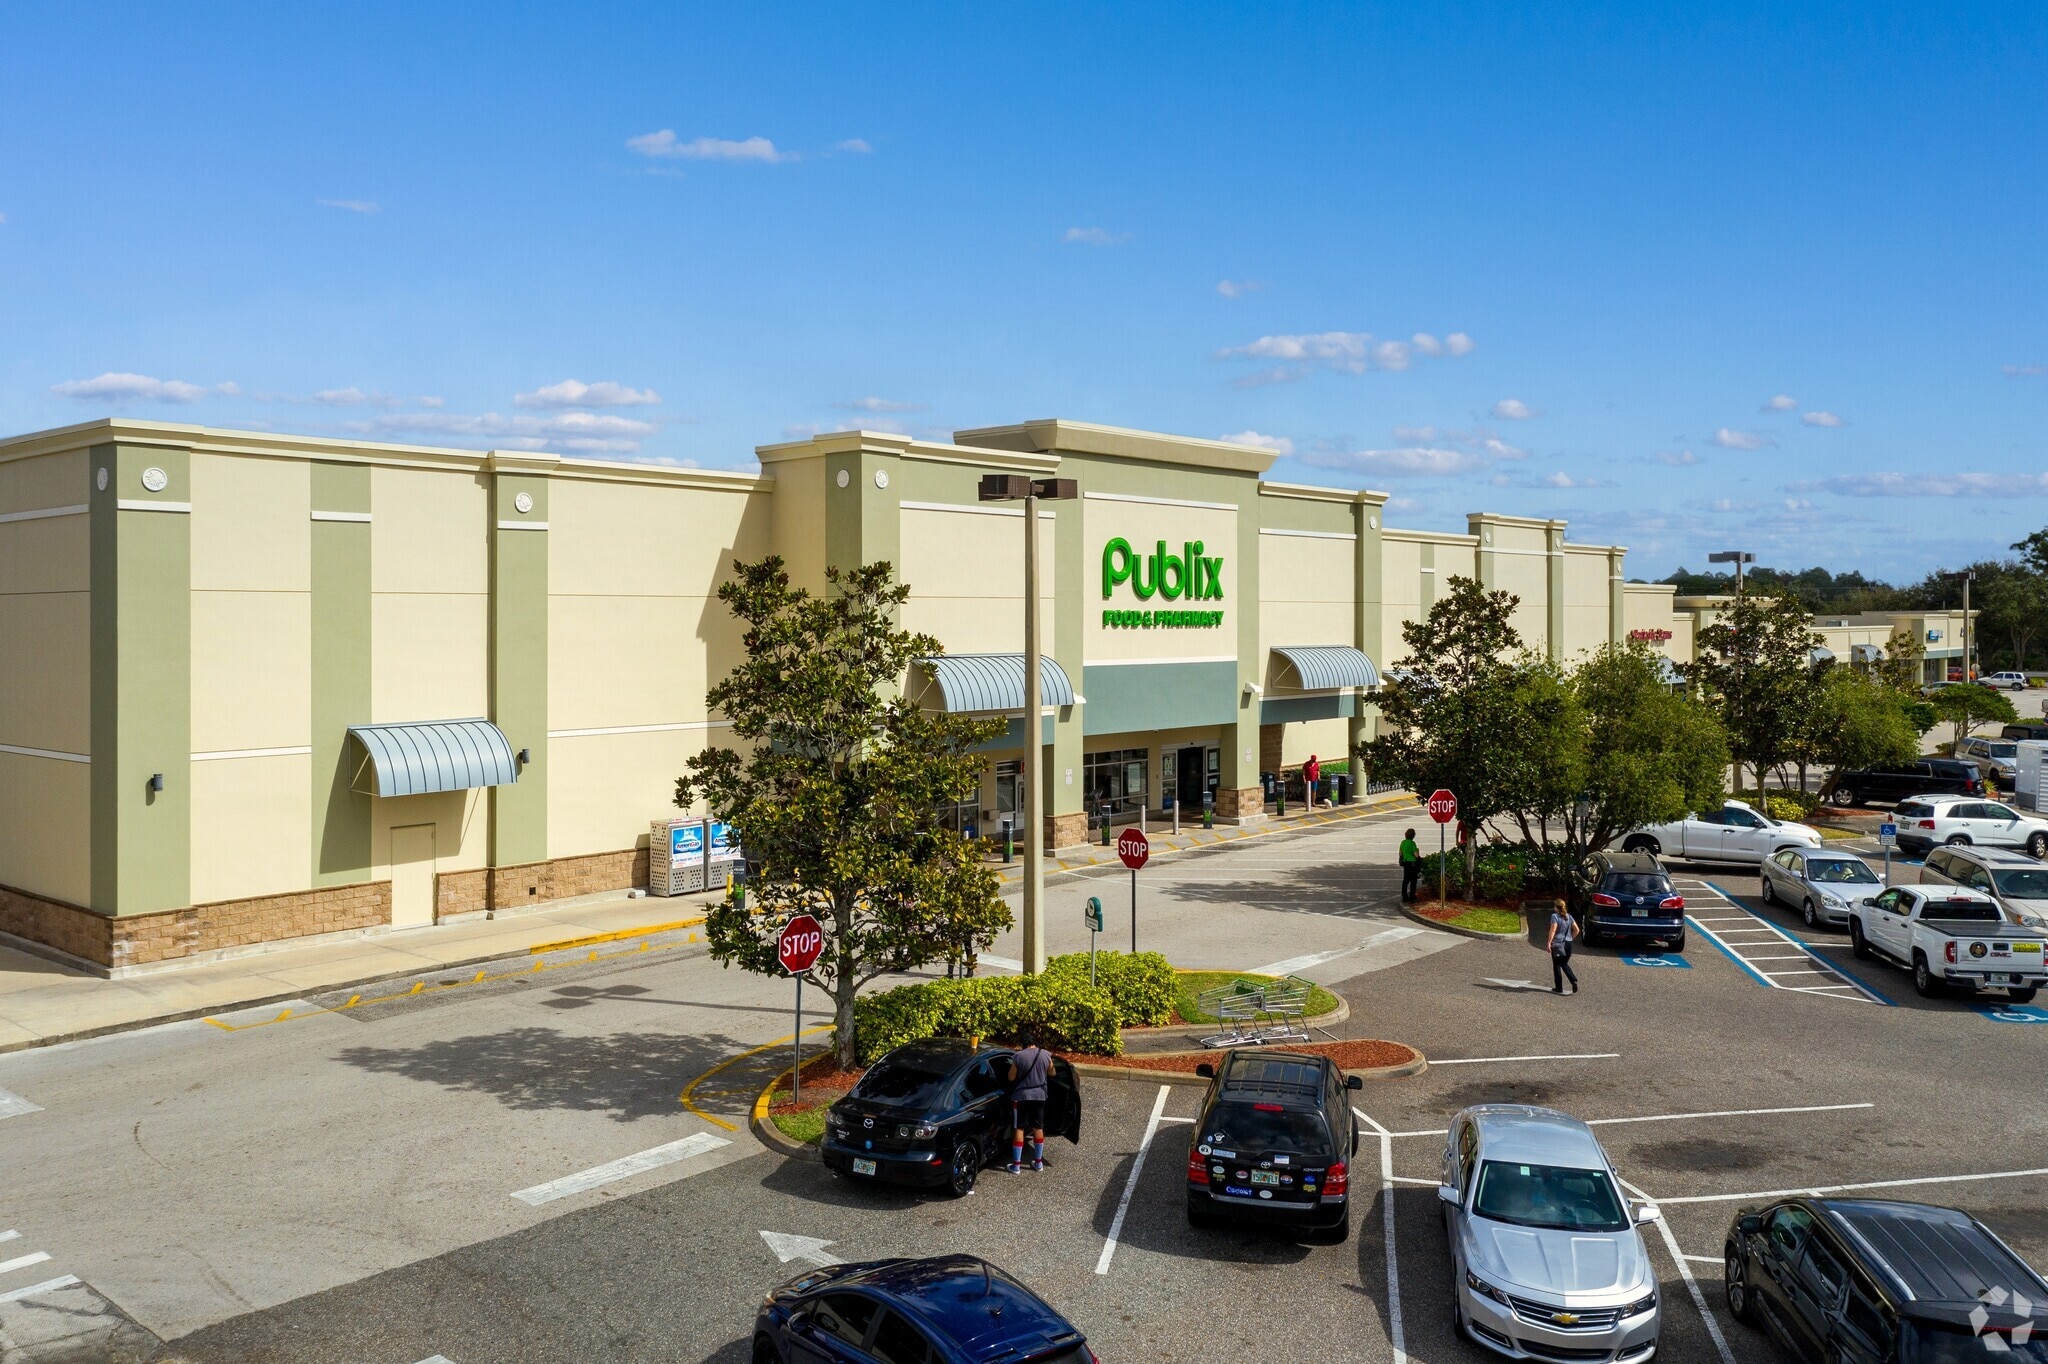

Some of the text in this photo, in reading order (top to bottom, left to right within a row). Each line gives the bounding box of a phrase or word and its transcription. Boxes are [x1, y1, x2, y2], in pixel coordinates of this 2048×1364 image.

[1102, 537, 1224, 600] Publix
[1102, 610, 1224, 627] FOOD & PHARMACY
[1430, 800, 1455, 814] STOP
[1120, 839, 1147, 858] STOP
[782, 931, 820, 957] STOP
